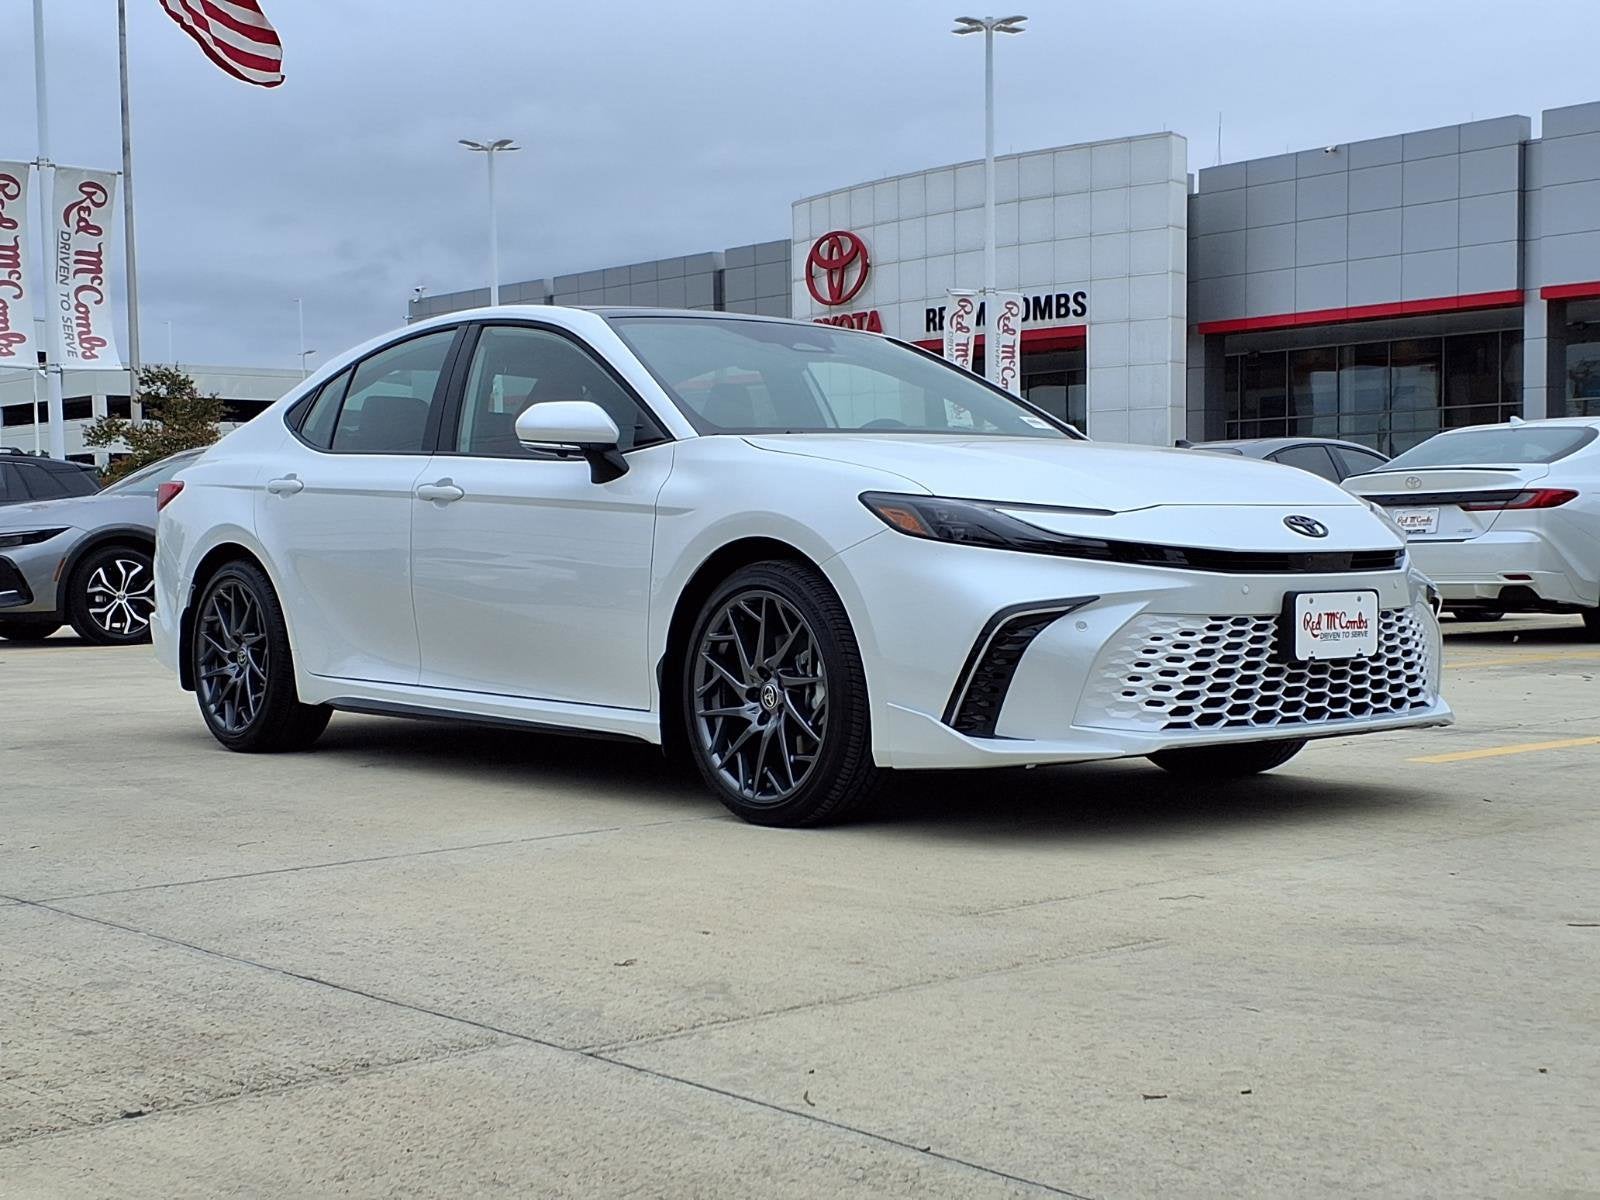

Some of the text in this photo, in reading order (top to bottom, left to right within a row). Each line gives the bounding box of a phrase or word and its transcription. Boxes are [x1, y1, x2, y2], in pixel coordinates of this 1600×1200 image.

[0, 173, 21, 230] Rd
[63, 181, 108, 360] Red McCombs
[59, 230, 79, 359] DRIVEN TO SERVE
[925, 306, 947, 333] RE
[949, 298, 974, 334] Red
[997, 301, 1020, 336] Red
[1303, 611, 1368, 638] Red McCombs
